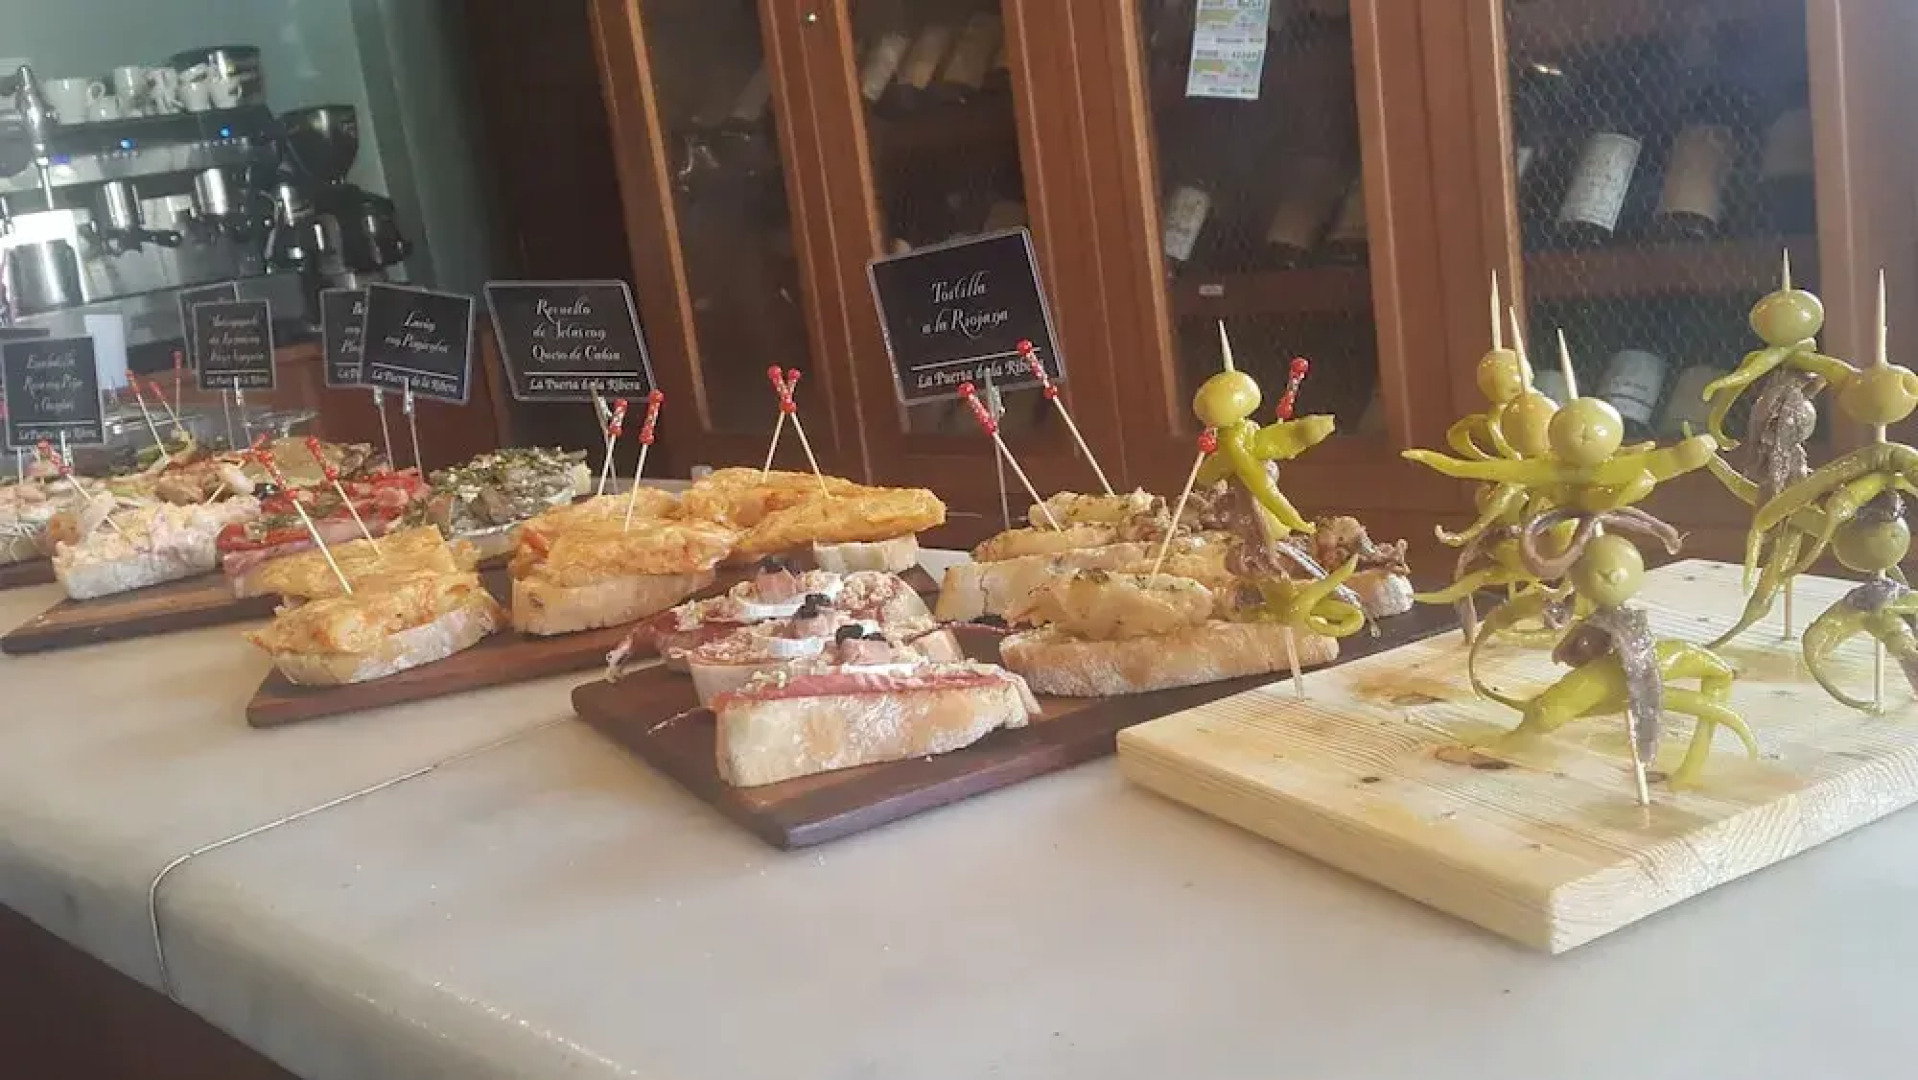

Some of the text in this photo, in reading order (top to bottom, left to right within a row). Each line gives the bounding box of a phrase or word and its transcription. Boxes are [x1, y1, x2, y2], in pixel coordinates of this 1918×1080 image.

[931, 271, 988, 304] Tortilla
[532, 323, 546, 338] de
[921, 308, 1008, 339] a la Riojana
[530, 379, 544, 390] La
[545, 379, 580, 390] Puerta
[918, 373, 932, 388] La
